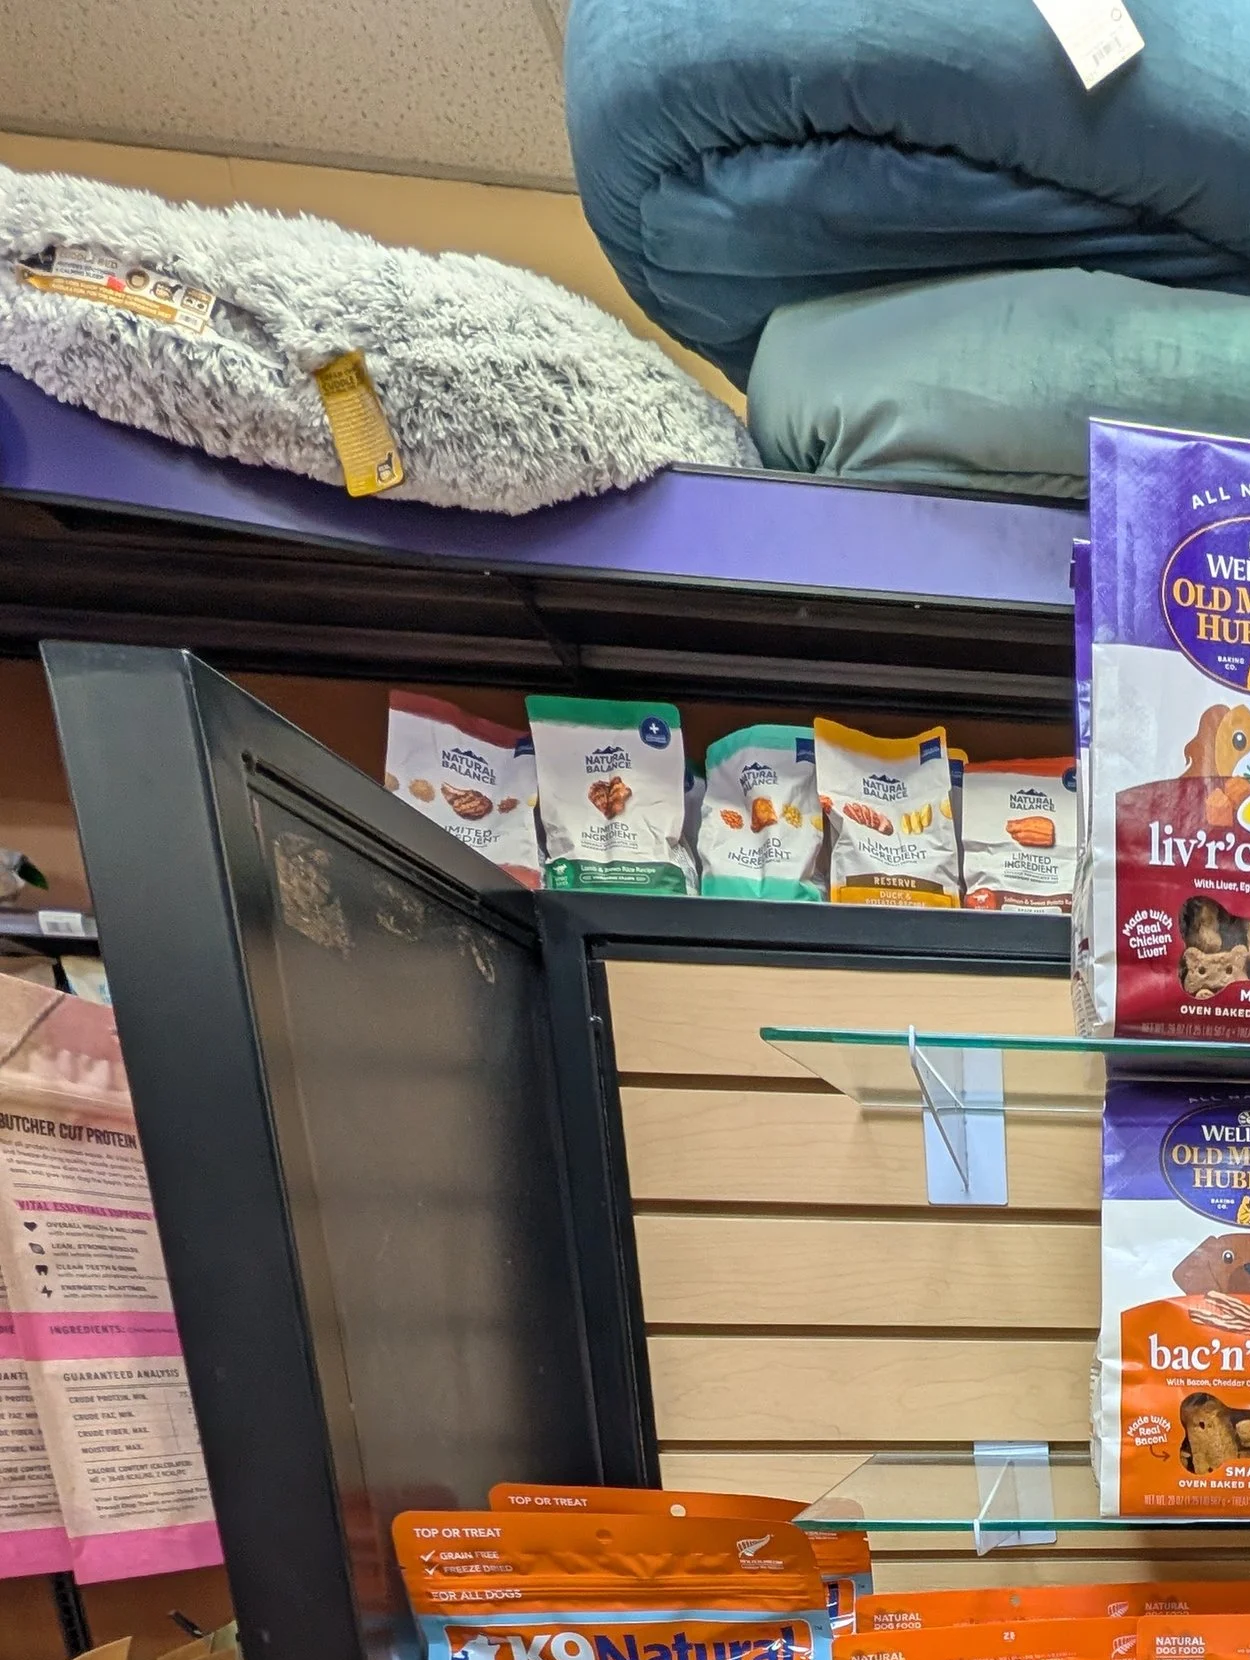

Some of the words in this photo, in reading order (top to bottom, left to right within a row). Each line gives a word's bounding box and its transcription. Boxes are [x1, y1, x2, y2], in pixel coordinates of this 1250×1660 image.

[1191, 487, 1231, 510] ALL
[1173, 579, 1232, 613] OLD
[585, 753, 630, 765] NATURAL
[586, 762, 631, 774] BALANCE
[863, 778, 906, 794] NATURAL
[863, 787, 907, 800] BALANCE
[1010, 794, 1054, 808] NATURAL
[1010, 801, 1055, 812] BALANCE
[590, 822, 629, 833] LIMITED
[582, 831, 637, 842] INGREDIENT
[1012, 853, 1052, 863] LIMITED
[1004, 860, 1058, 874] INGREDIENT
[874, 876, 916, 888] RESERVE
[1194, 879, 1214, 889] With
[1216, 879, 1239, 892] Liver,
[1180, 1006, 1211, 1017] OVEN
[59, 1124, 83, 1141] CUT
[87, 1128, 137, 1149] PROTEIN
[1172, 1144, 1223, 1166] OLD
[50, 1325, 127, 1334] INGREDIENTS:
[64, 1372, 133, 1381] GUARANTEED
[137, 1369, 179, 1378] ANALYSIS
[414, 1527, 439, 1538] TOP
[441, 1527, 459, 1538] OR
[462, 1527, 502, 1538] TREAT
